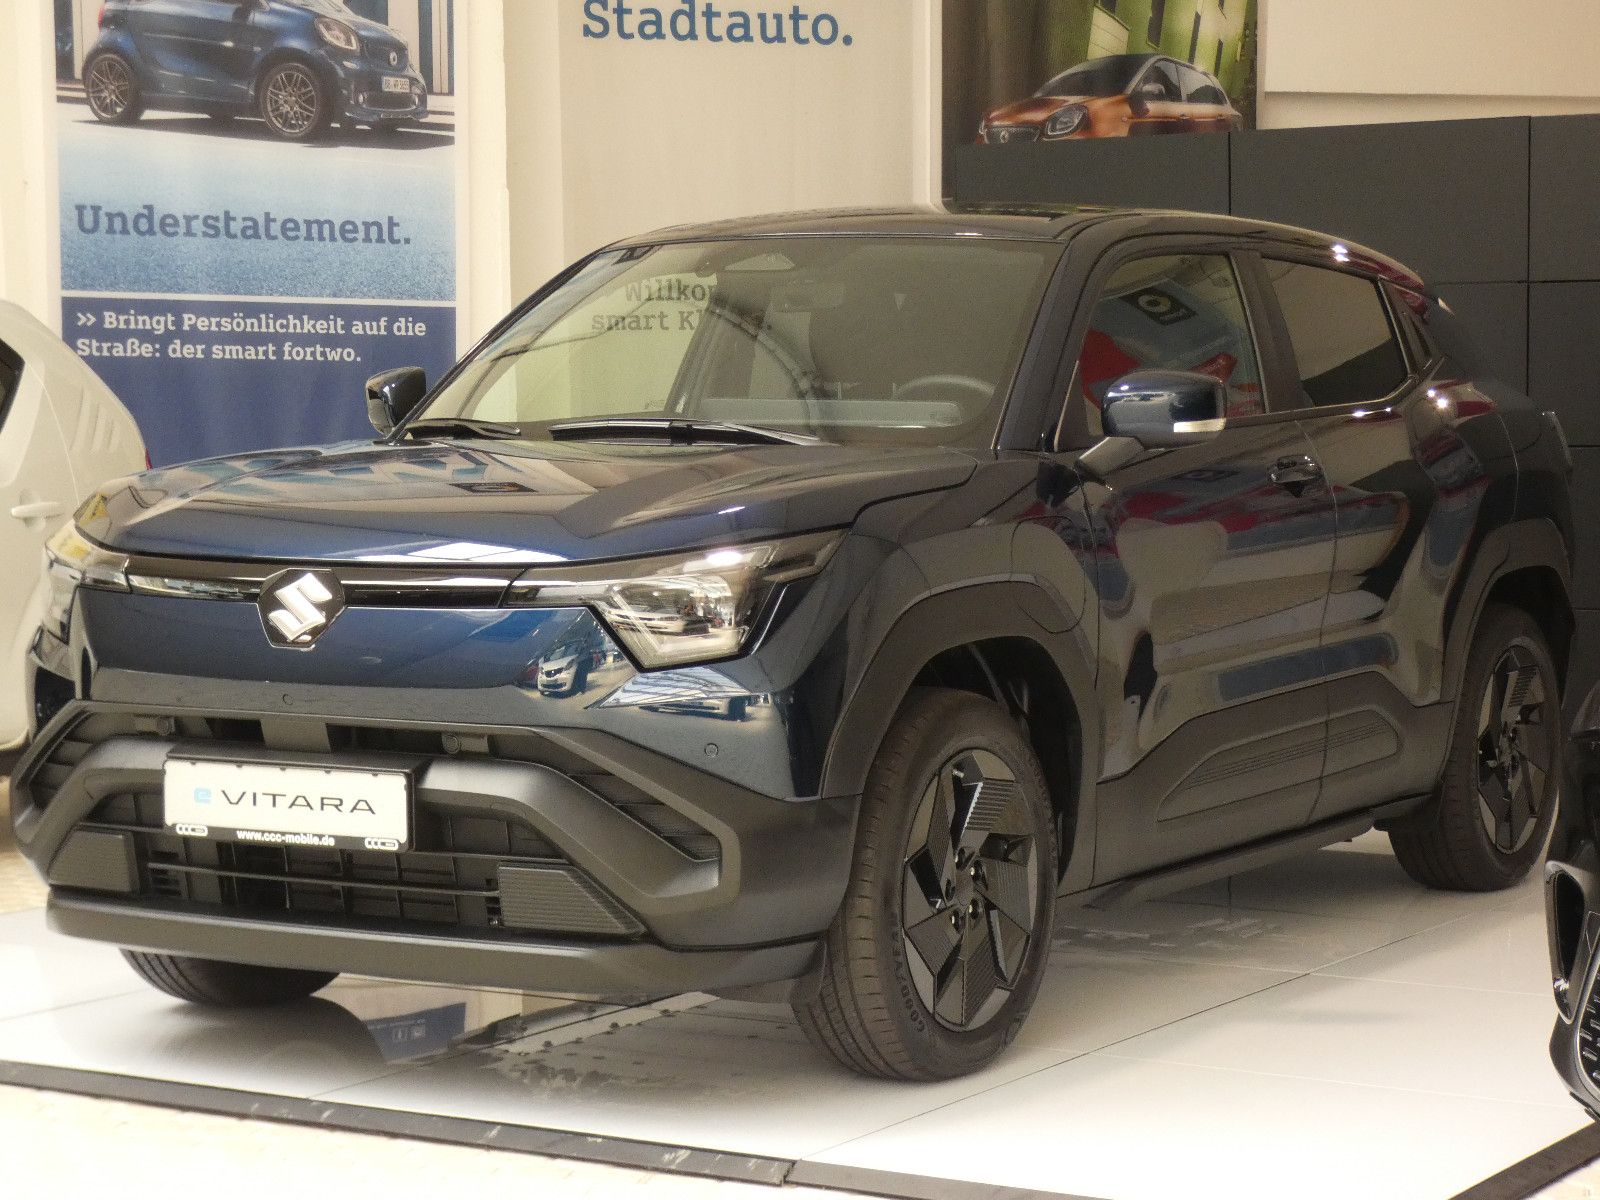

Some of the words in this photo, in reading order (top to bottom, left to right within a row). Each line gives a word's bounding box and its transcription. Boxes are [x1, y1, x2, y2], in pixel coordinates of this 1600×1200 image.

[582, 0, 853, 46] Stadtauto.
[74, 203, 411, 245] Understatement.
[103, 309, 176, 335] Bringt
[182, 312, 346, 334] Persönlichkeit
[351, 317, 388, 336] auf
[393, 317, 427, 336] die
[591, 310, 670, 332] smart
[76, 338, 161, 358] Straße:
[168, 339, 205, 359] der
[212, 342, 277, 360] smart
[283, 341, 362, 362] fortwo.
[221, 789, 376, 815] VITARA
[235, 830, 336, 847] www.ccc-mobile.de
